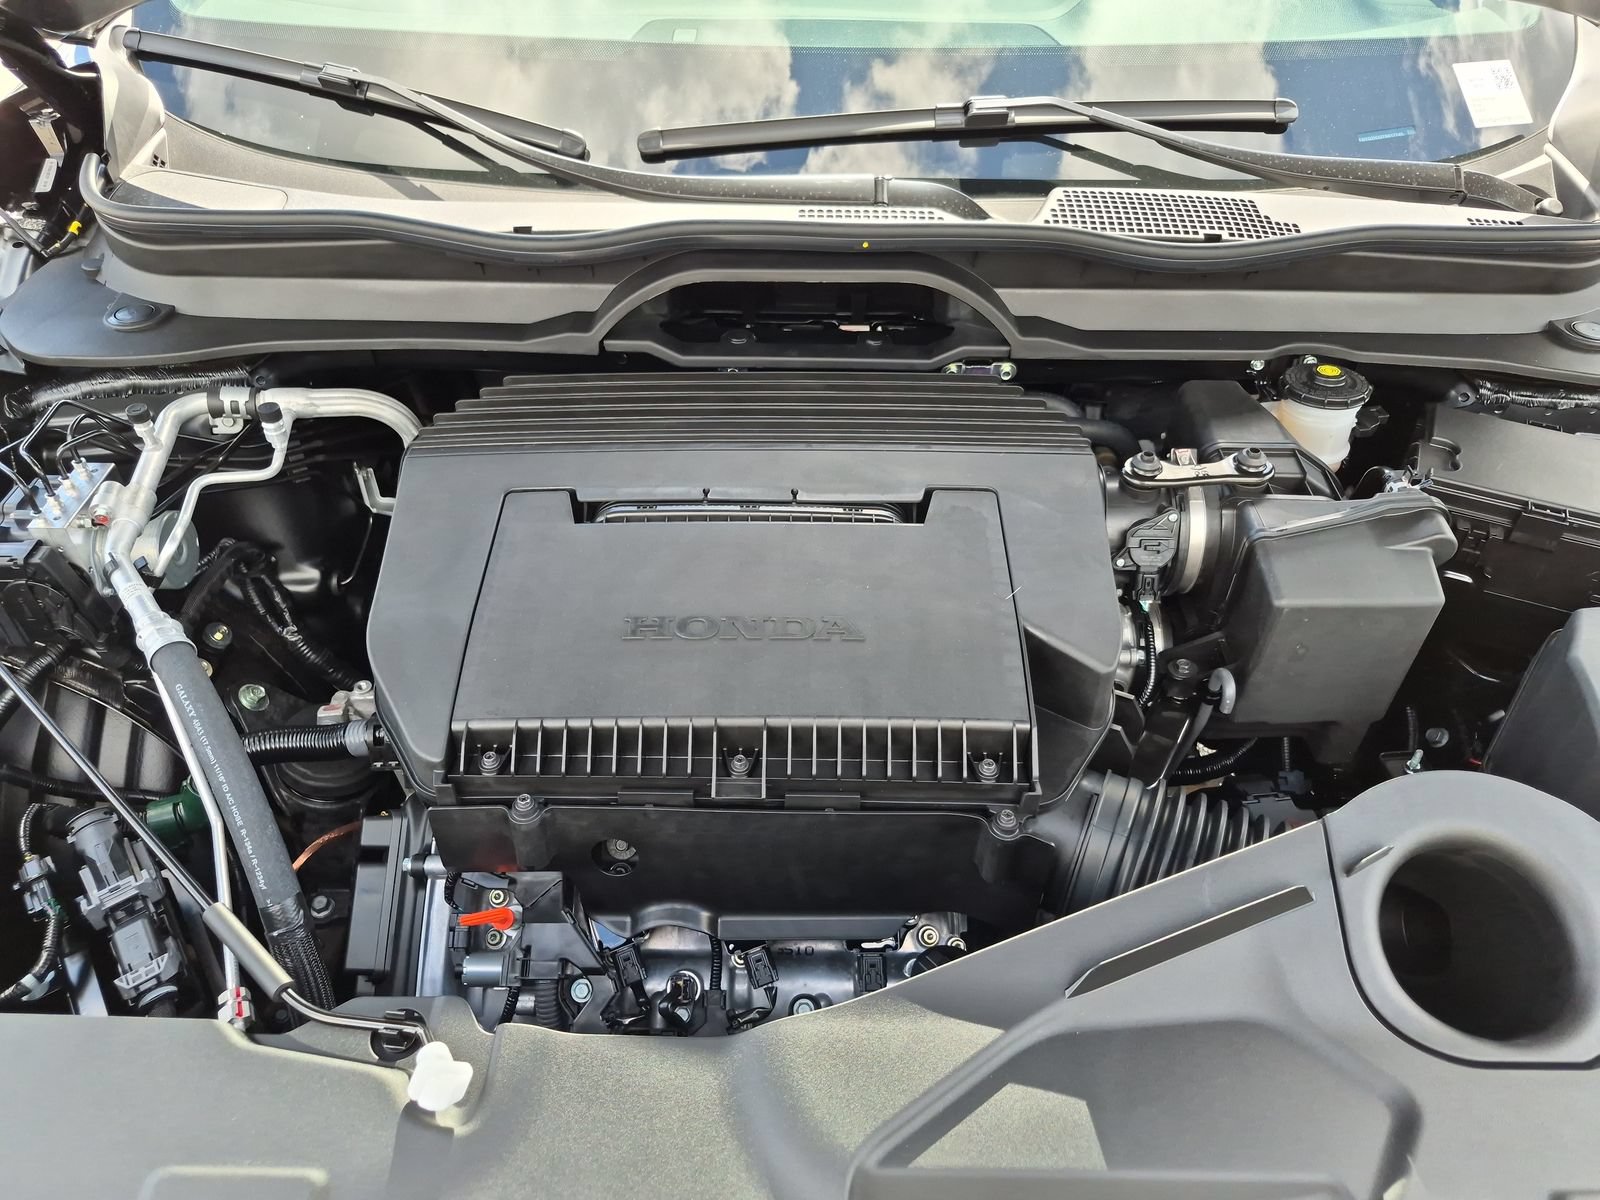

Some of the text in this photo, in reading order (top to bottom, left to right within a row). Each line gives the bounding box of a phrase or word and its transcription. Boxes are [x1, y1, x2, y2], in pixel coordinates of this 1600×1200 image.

[621, 615, 866, 641] HONDA
[175, 683, 197, 718] GALAXY
[221, 783, 230, 792] ID
[225, 793, 235, 805] A/C
[230, 805, 244, 827] HOSE
[240, 828, 253, 855] R-134a
